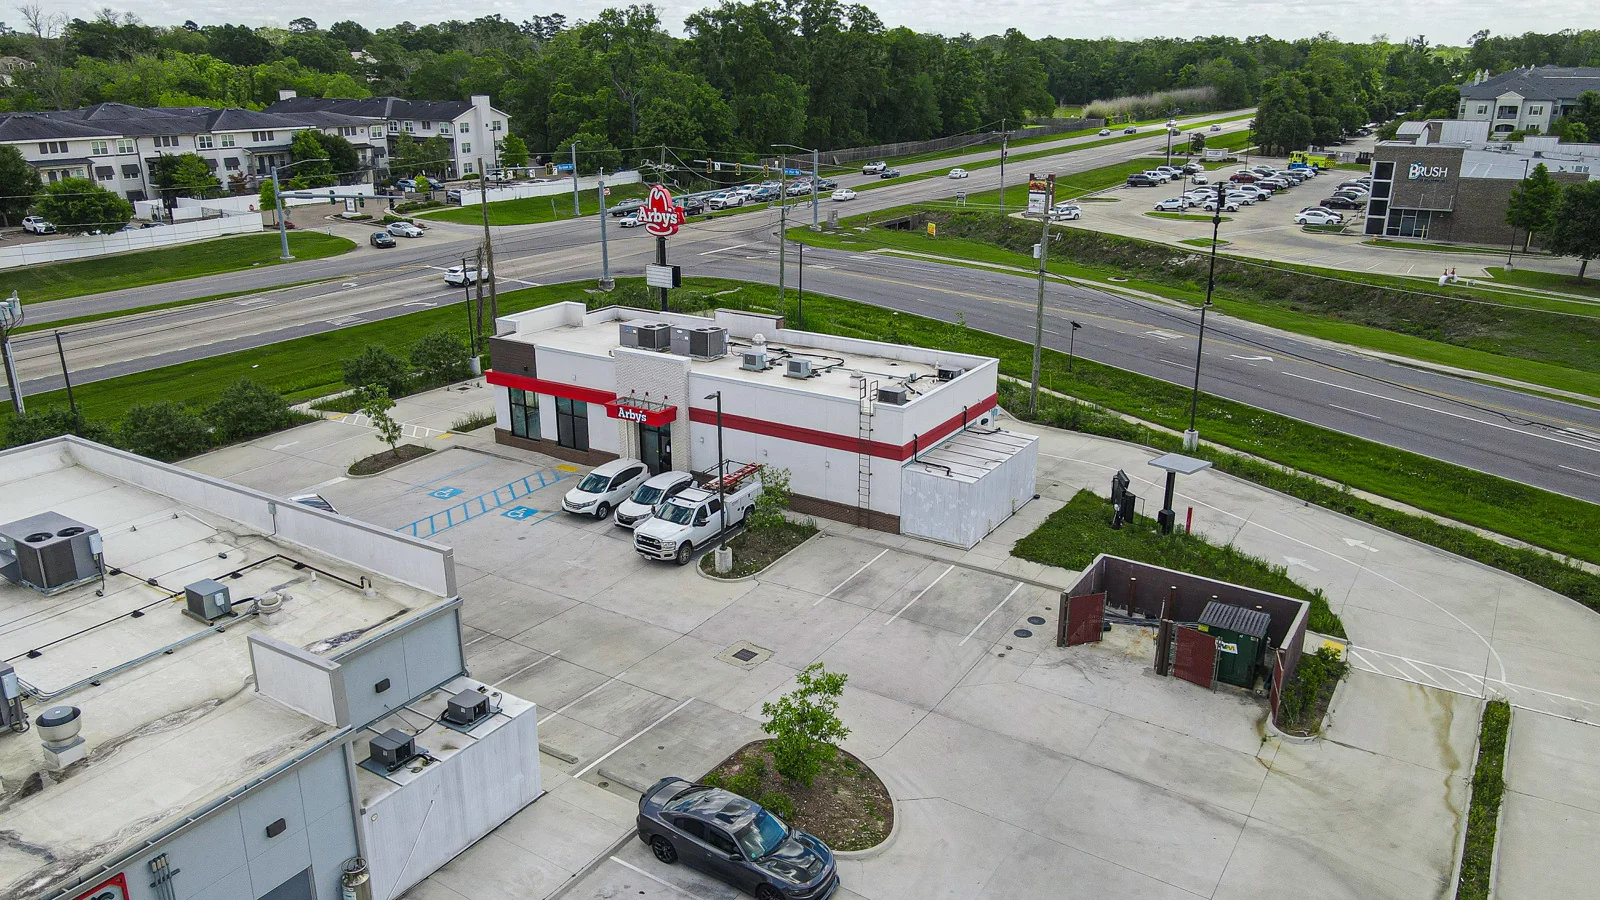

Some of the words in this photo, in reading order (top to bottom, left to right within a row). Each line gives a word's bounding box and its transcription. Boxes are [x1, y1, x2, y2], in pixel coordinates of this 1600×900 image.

[1409, 163, 1448, 179] BRUSH
[637, 206, 678, 228] Arby's
[618, 407, 647, 423] Arby's
